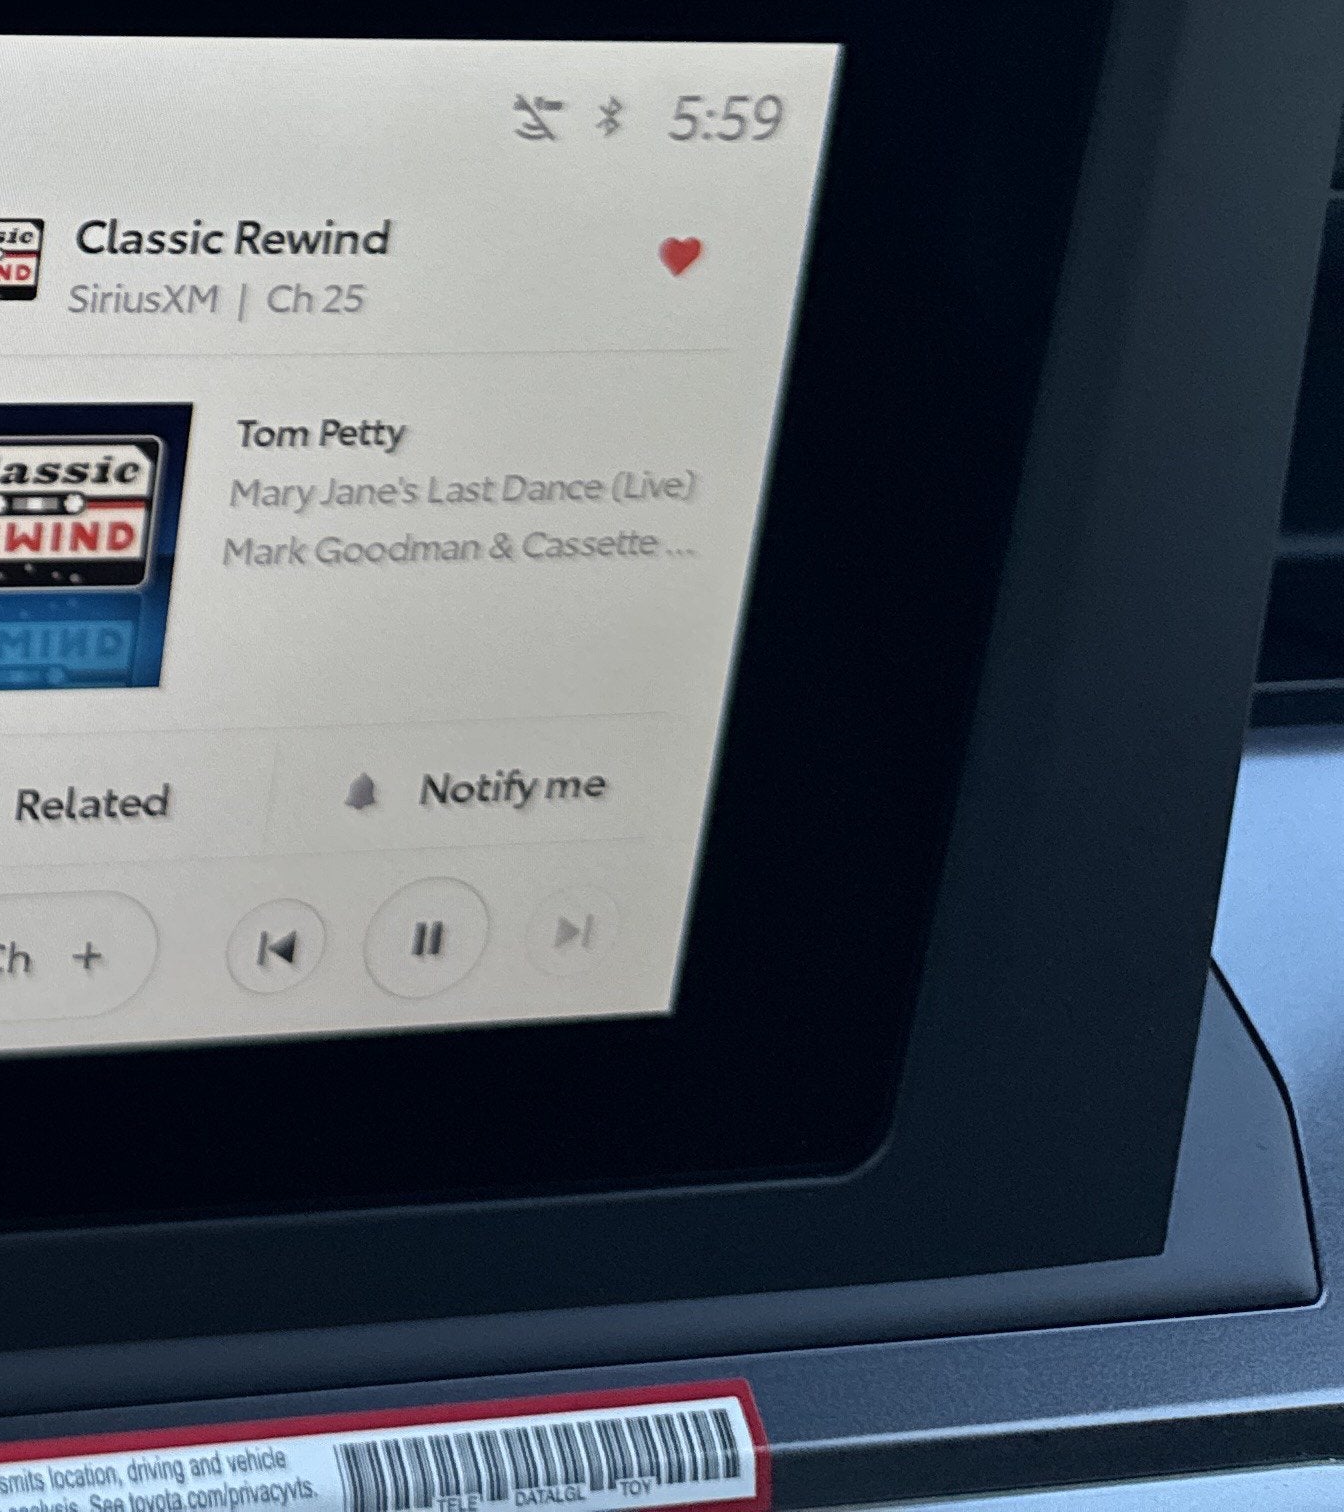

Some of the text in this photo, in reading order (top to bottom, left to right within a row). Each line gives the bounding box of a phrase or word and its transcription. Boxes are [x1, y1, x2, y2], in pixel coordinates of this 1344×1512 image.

[668, 94, 785, 143] 5:59
[75, 218, 392, 257] Classic Rewind
[67, 282, 366, 315] SiriusXM Ch 25
[236, 419, 408, 454] Tom Petty
[229, 469, 699, 515] Mary Jane's Last Dance (Live)
[222, 536, 307, 567] Mark
[314, 532, 482, 566] Goodman
[488, 532, 513, 561] &
[521, 530, 658, 561] Cassette
[14, 784, 171, 823] Related
[418, 768, 607, 811] Notify me
[48, 1461, 123, 1489] location,
[127, 1454, 185, 1485] driving
[188, 1449, 223, 1477] and
[226, 1445, 287, 1473] vehicle
[89, 1493, 125, 1512] See
[620, 1478, 653, 1496] TOY
